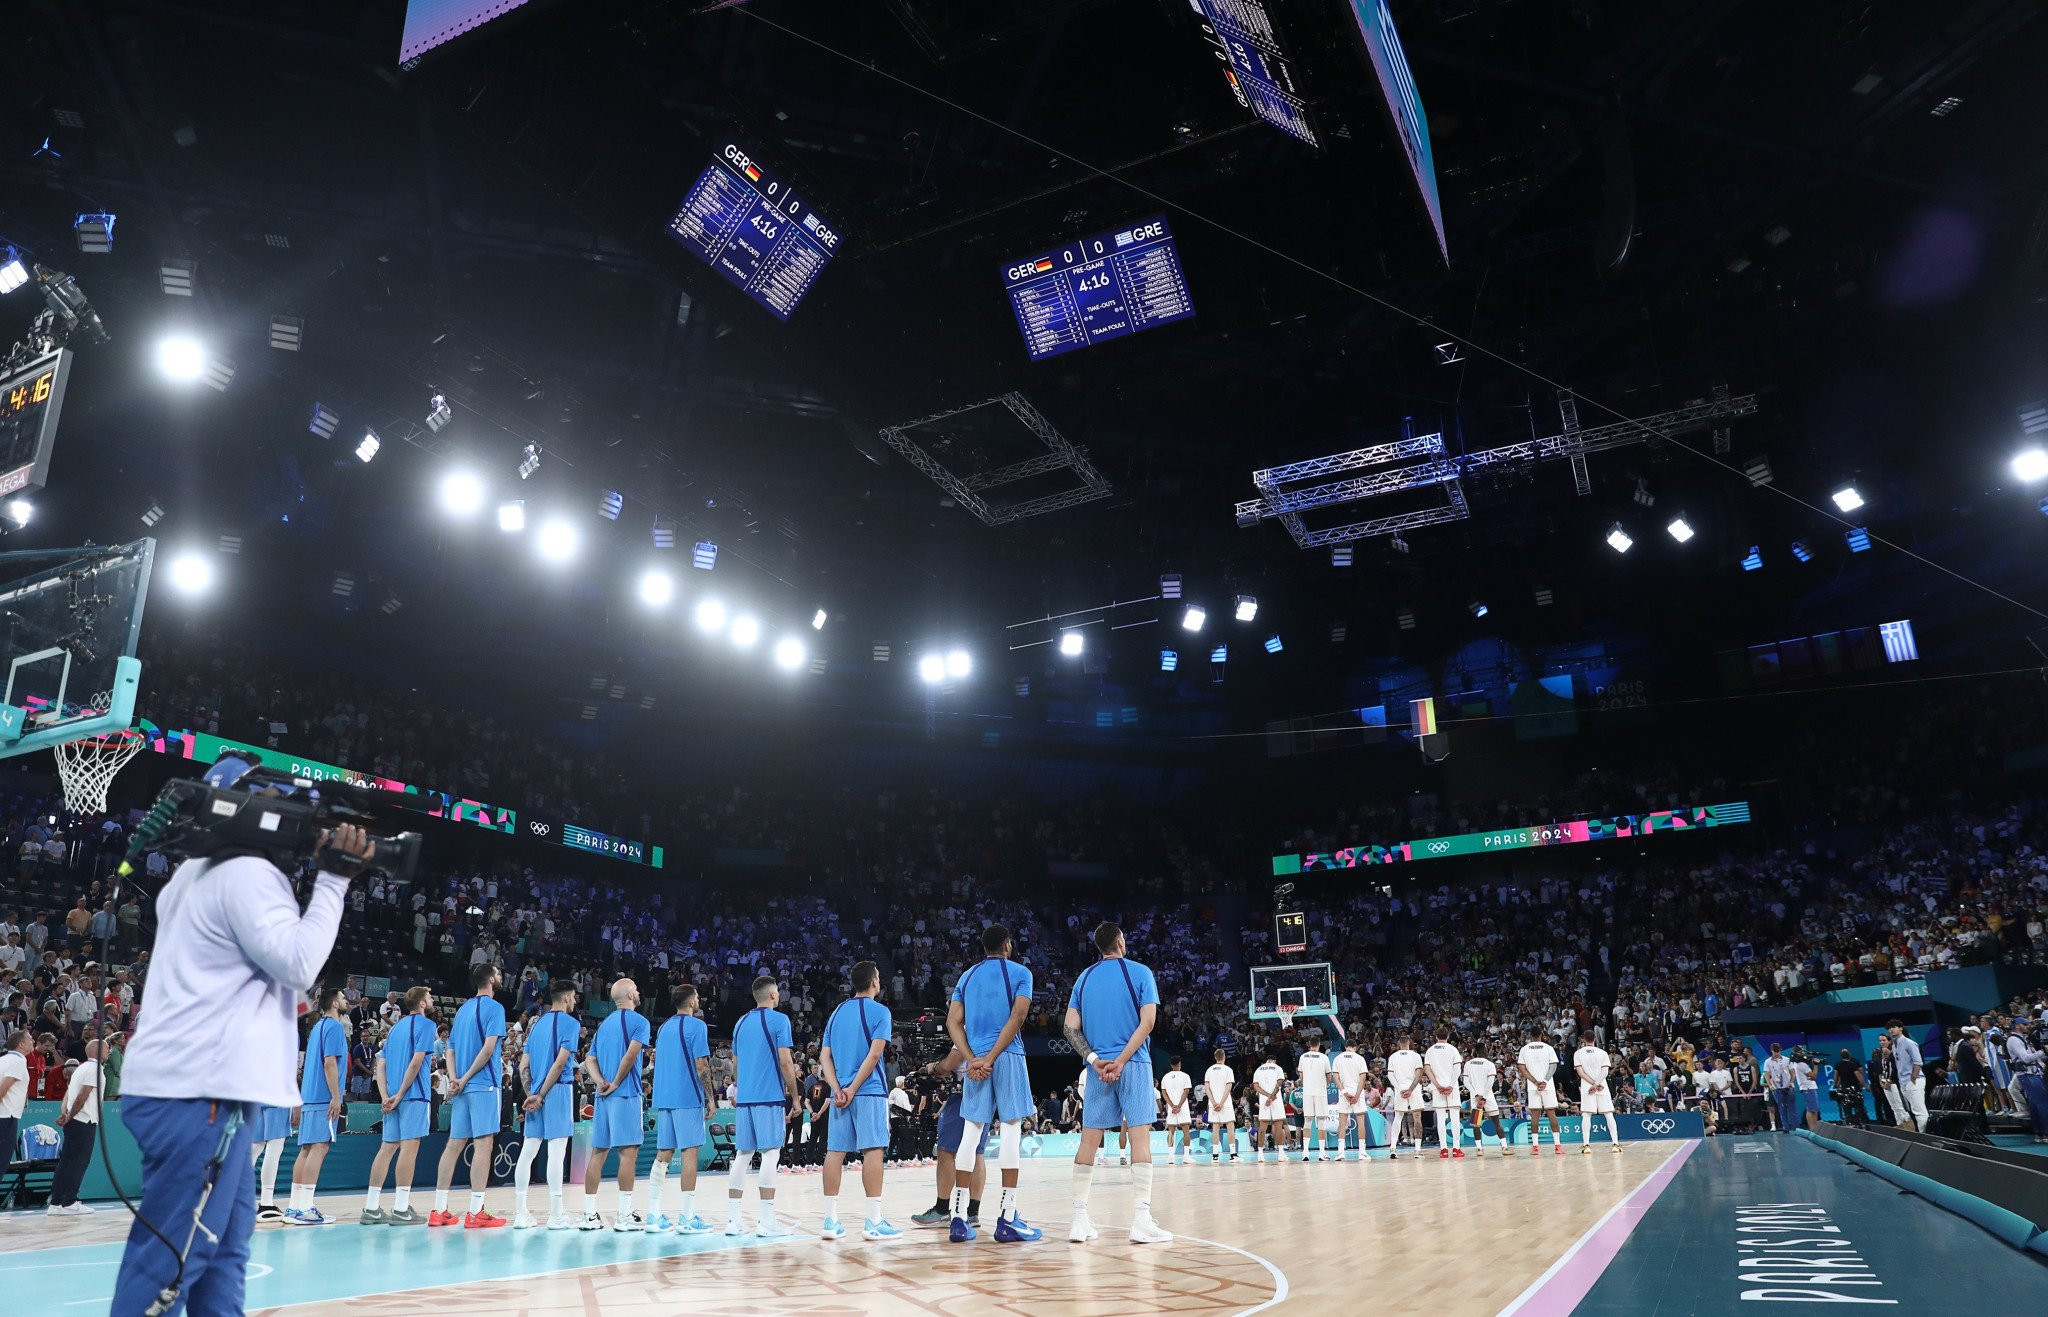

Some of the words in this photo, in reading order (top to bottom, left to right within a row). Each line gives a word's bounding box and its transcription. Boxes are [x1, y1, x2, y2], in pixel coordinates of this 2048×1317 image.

[1231, 41, 1252, 72] 4:16
[724, 144, 750, 171] GER
[767, 182, 778, 195] 0
[761, 200, 786, 224] PRE-GAME
[789, 201, 800, 214] 0
[750, 214, 778, 239] 4:16
[814, 224, 839, 248] GRE
[1133, 222, 1163, 241] GRE
[1063, 250, 1073, 263] 0
[1094, 241, 1104, 254] 0
[721, 257, 735, 270] TEAM
[733, 267, 747, 279] FOULS
[1008, 262, 1036, 280] GER
[1072, 260, 1105, 275] PRE-GAME
[1078, 272, 1110, 292] 4:16
[1087, 300, 1117, 312] TIME-OUTS
[1092, 326, 1108, 335] TEAM
[1108, 321, 1126, 330] FOULS
[576, 833, 609, 851] PARIS
[613, 842, 641, 858] 2024
[1484, 833, 1527, 847] PARIS
[1532, 828, 1571, 842] 2024
